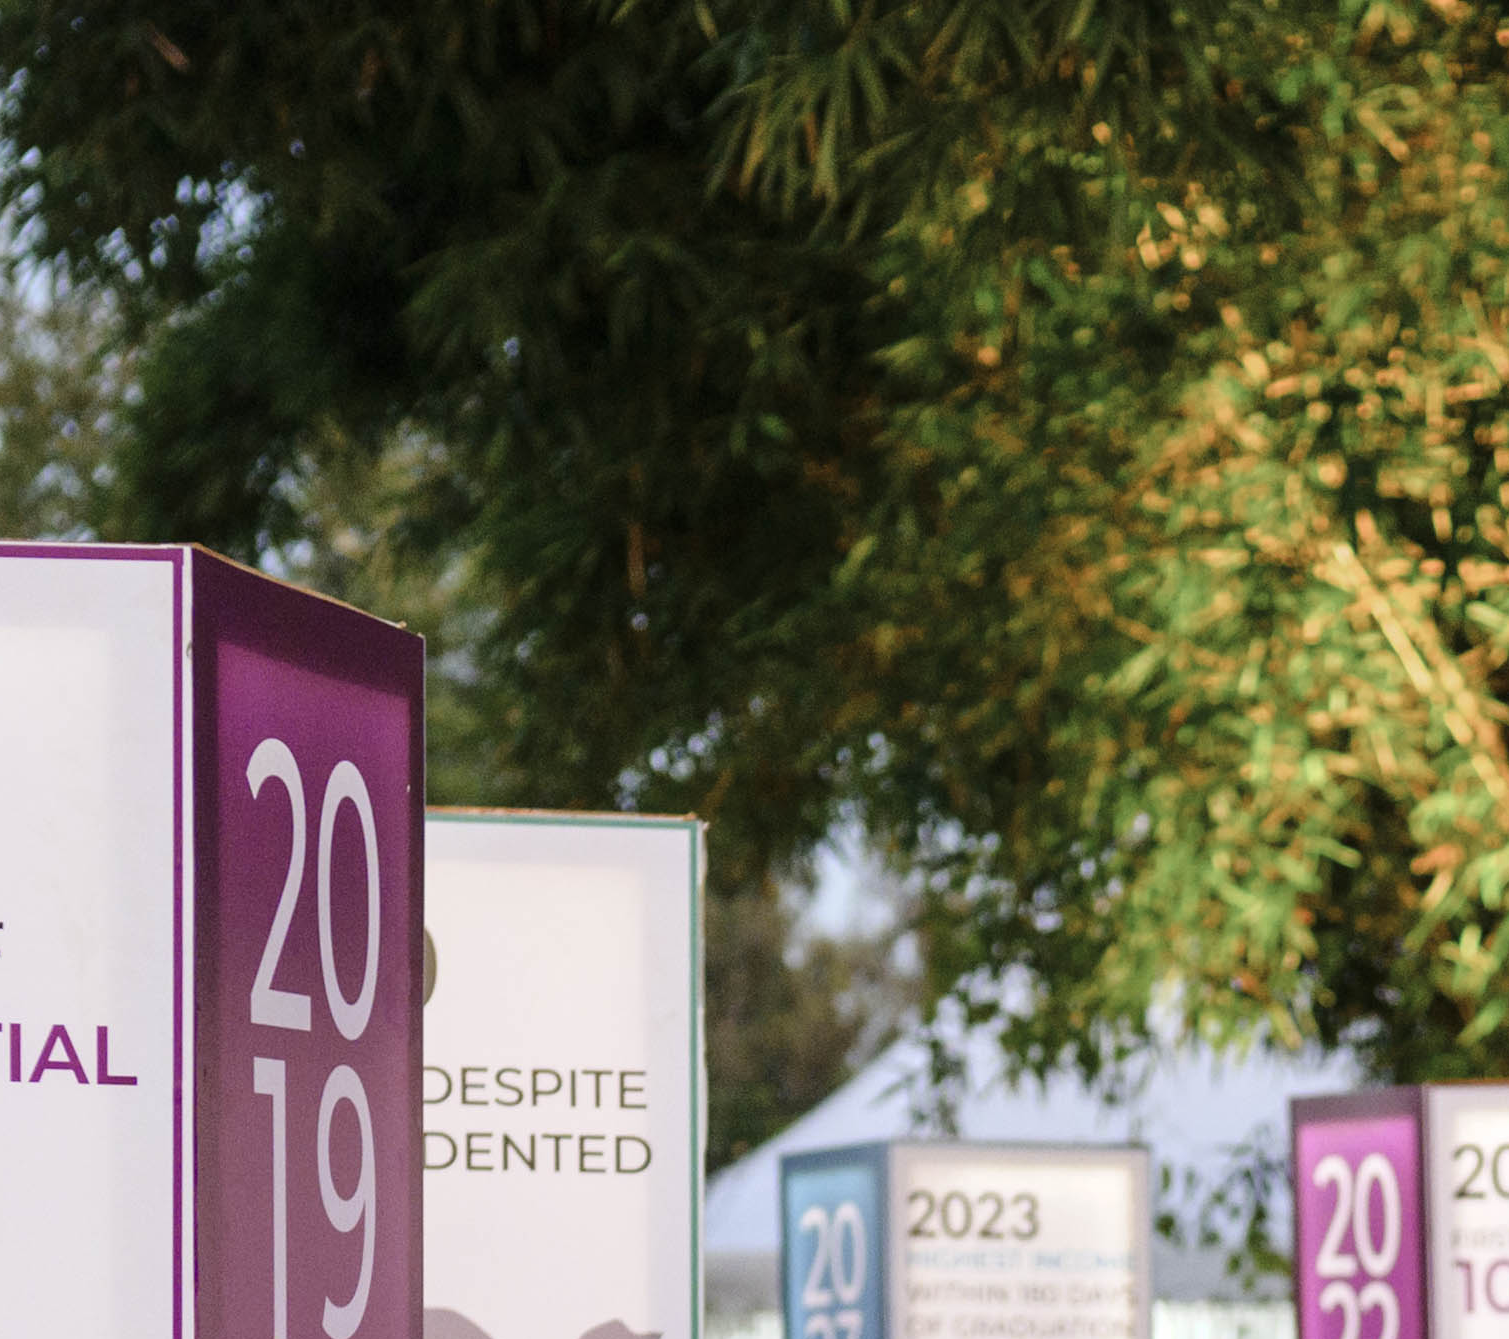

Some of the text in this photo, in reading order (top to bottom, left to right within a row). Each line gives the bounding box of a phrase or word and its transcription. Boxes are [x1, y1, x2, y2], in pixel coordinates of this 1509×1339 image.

[246, 738, 380, 1040] 20
[423, 1066, 647, 1109] DESPITE
[800, 1202, 867, 1307] 20
[907, 1190, 1040, 1240] 2023
[1312, 1153, 1401, 1278] 20
